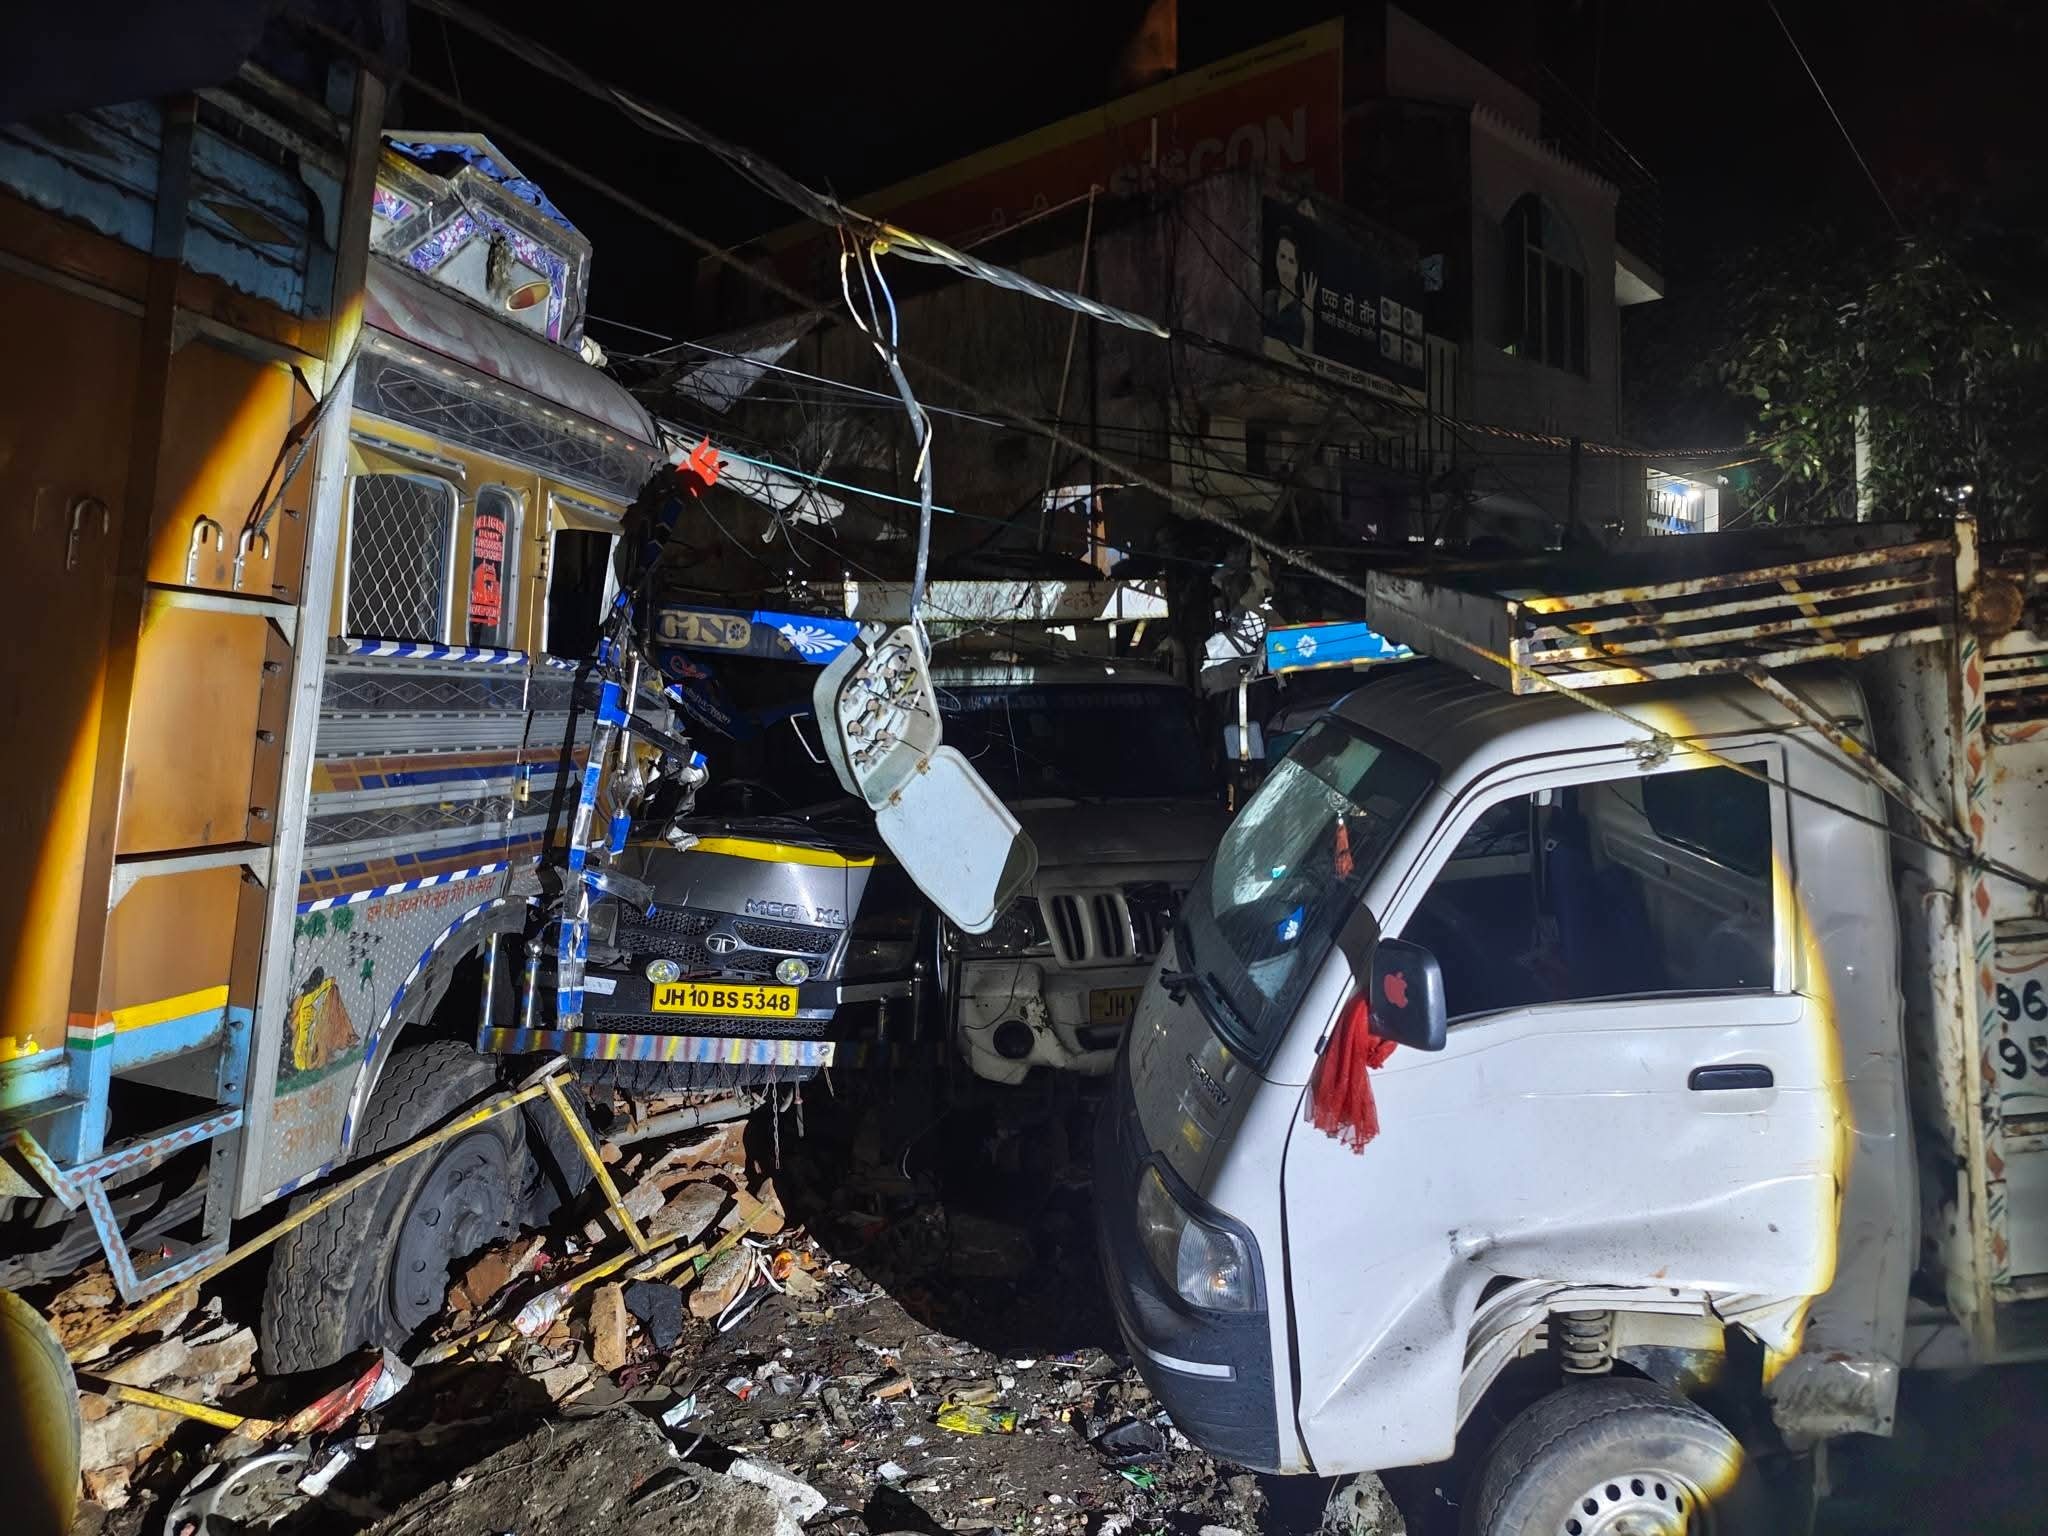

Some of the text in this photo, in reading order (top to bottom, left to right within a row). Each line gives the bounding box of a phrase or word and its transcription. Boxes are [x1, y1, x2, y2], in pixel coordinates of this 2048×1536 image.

[1321, 287, 1340, 310] एक
[659, 988, 791, 1012] JH 10 BS 5348
